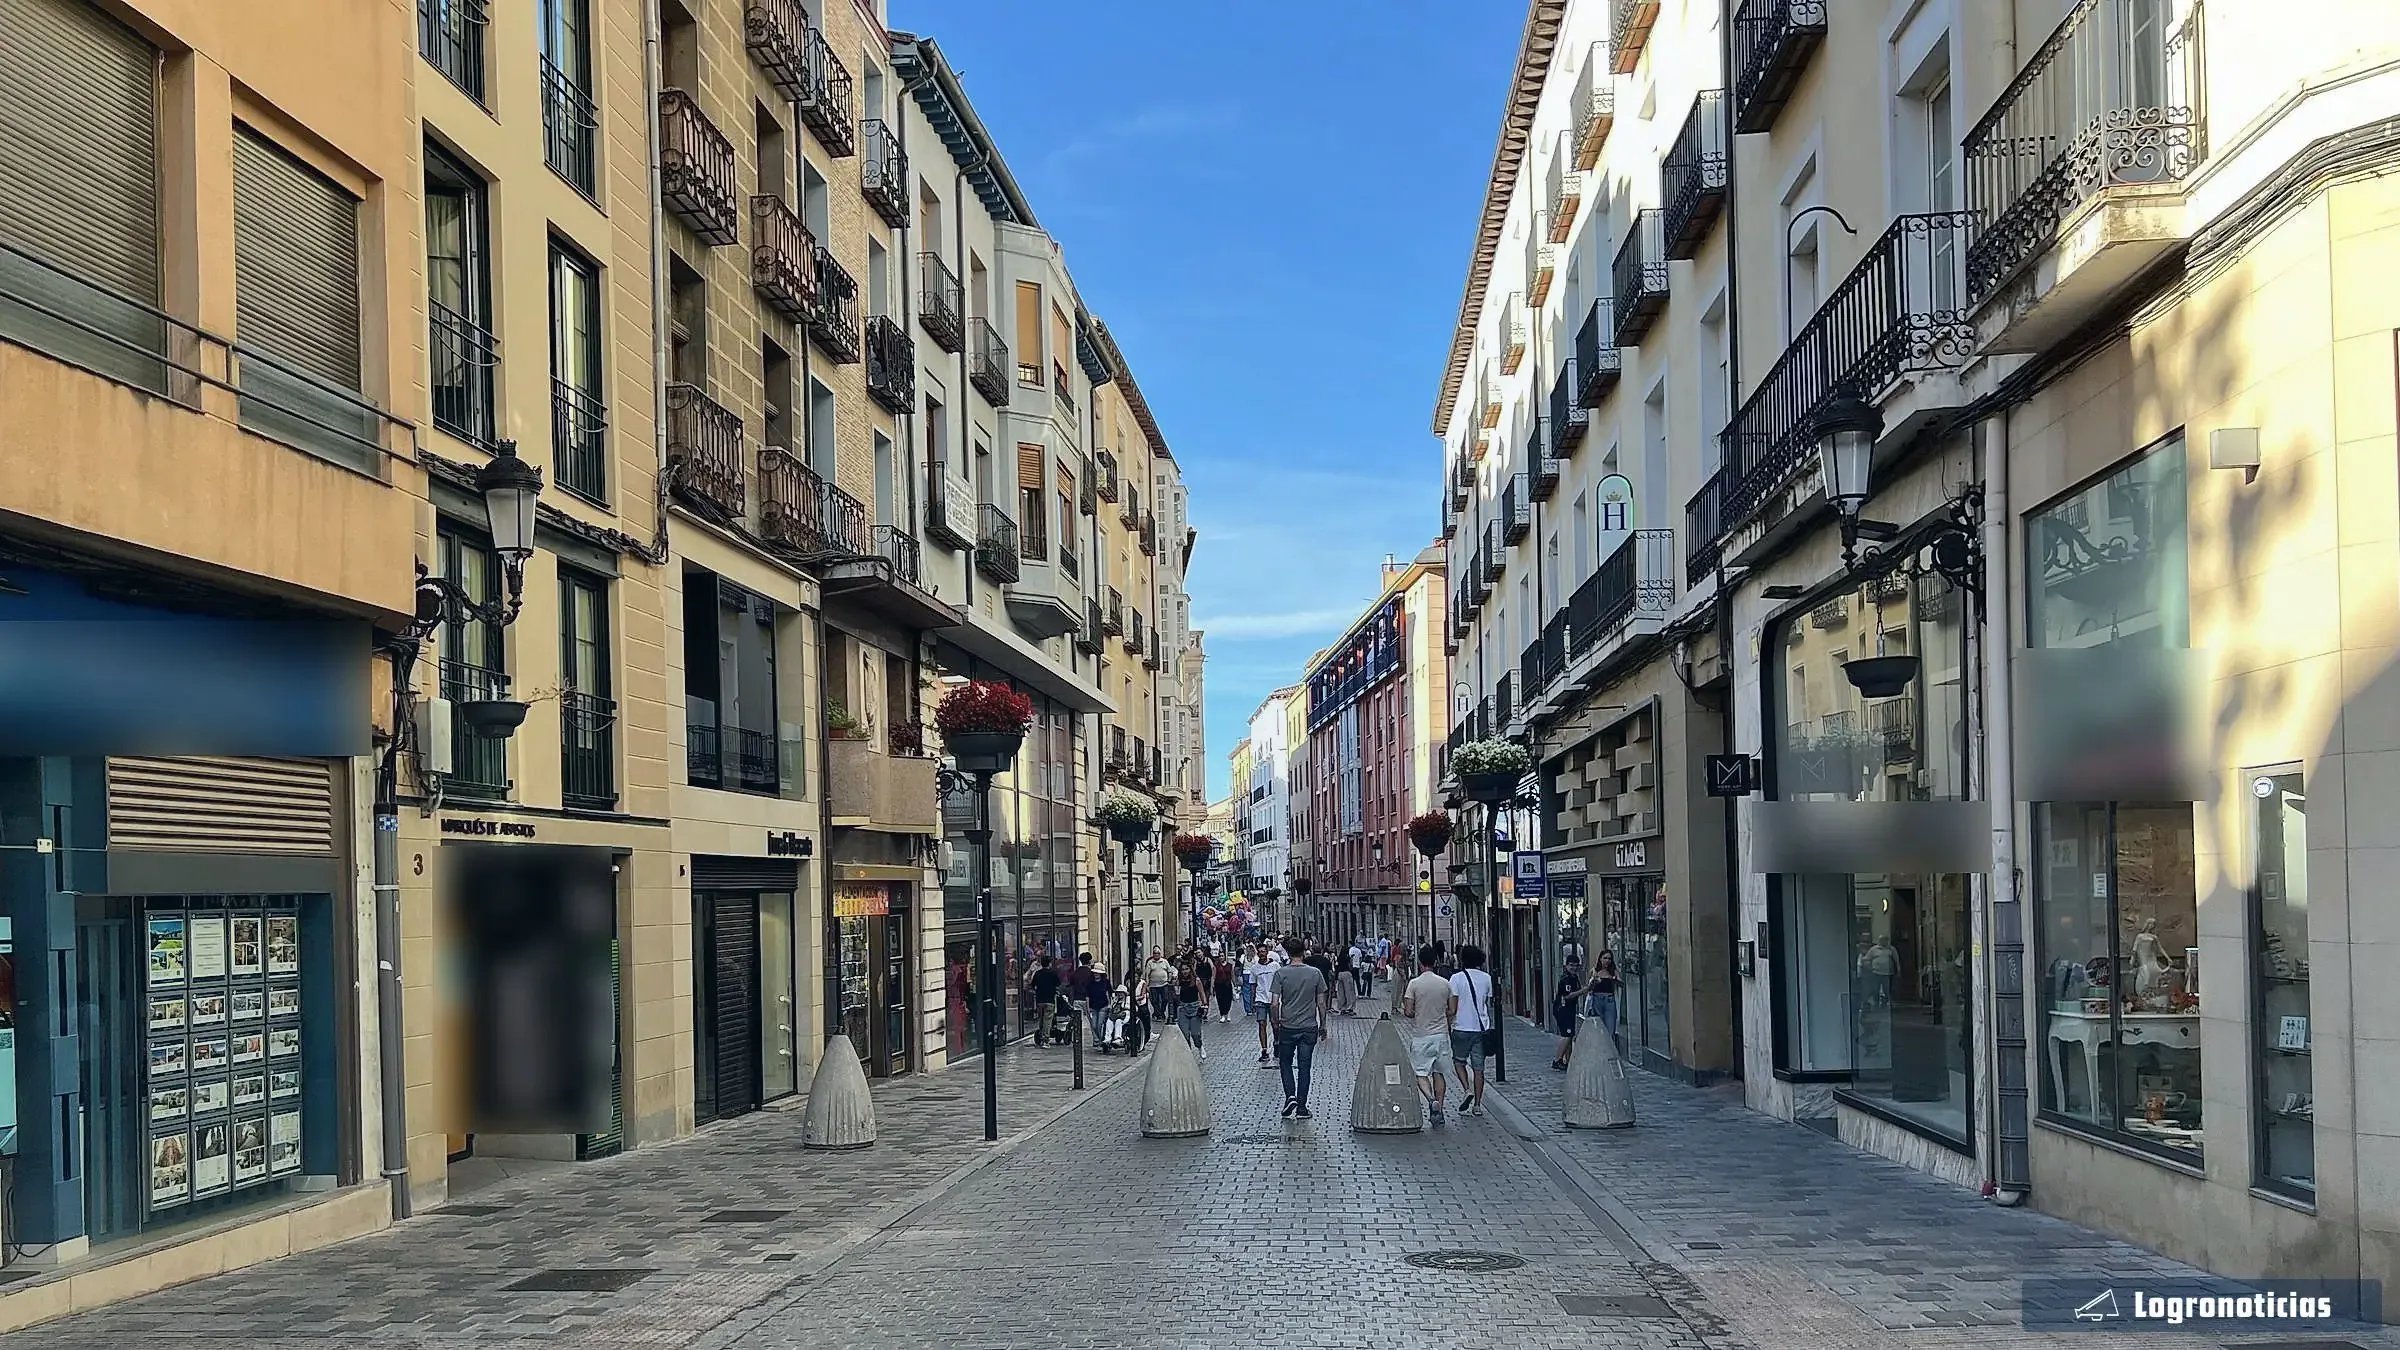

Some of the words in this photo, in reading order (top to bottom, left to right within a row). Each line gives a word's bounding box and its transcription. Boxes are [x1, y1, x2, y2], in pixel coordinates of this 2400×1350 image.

[1602, 502, 1627, 531] H
[487, 821, 498, 835] DE
[413, 853, 424, 876] 3
